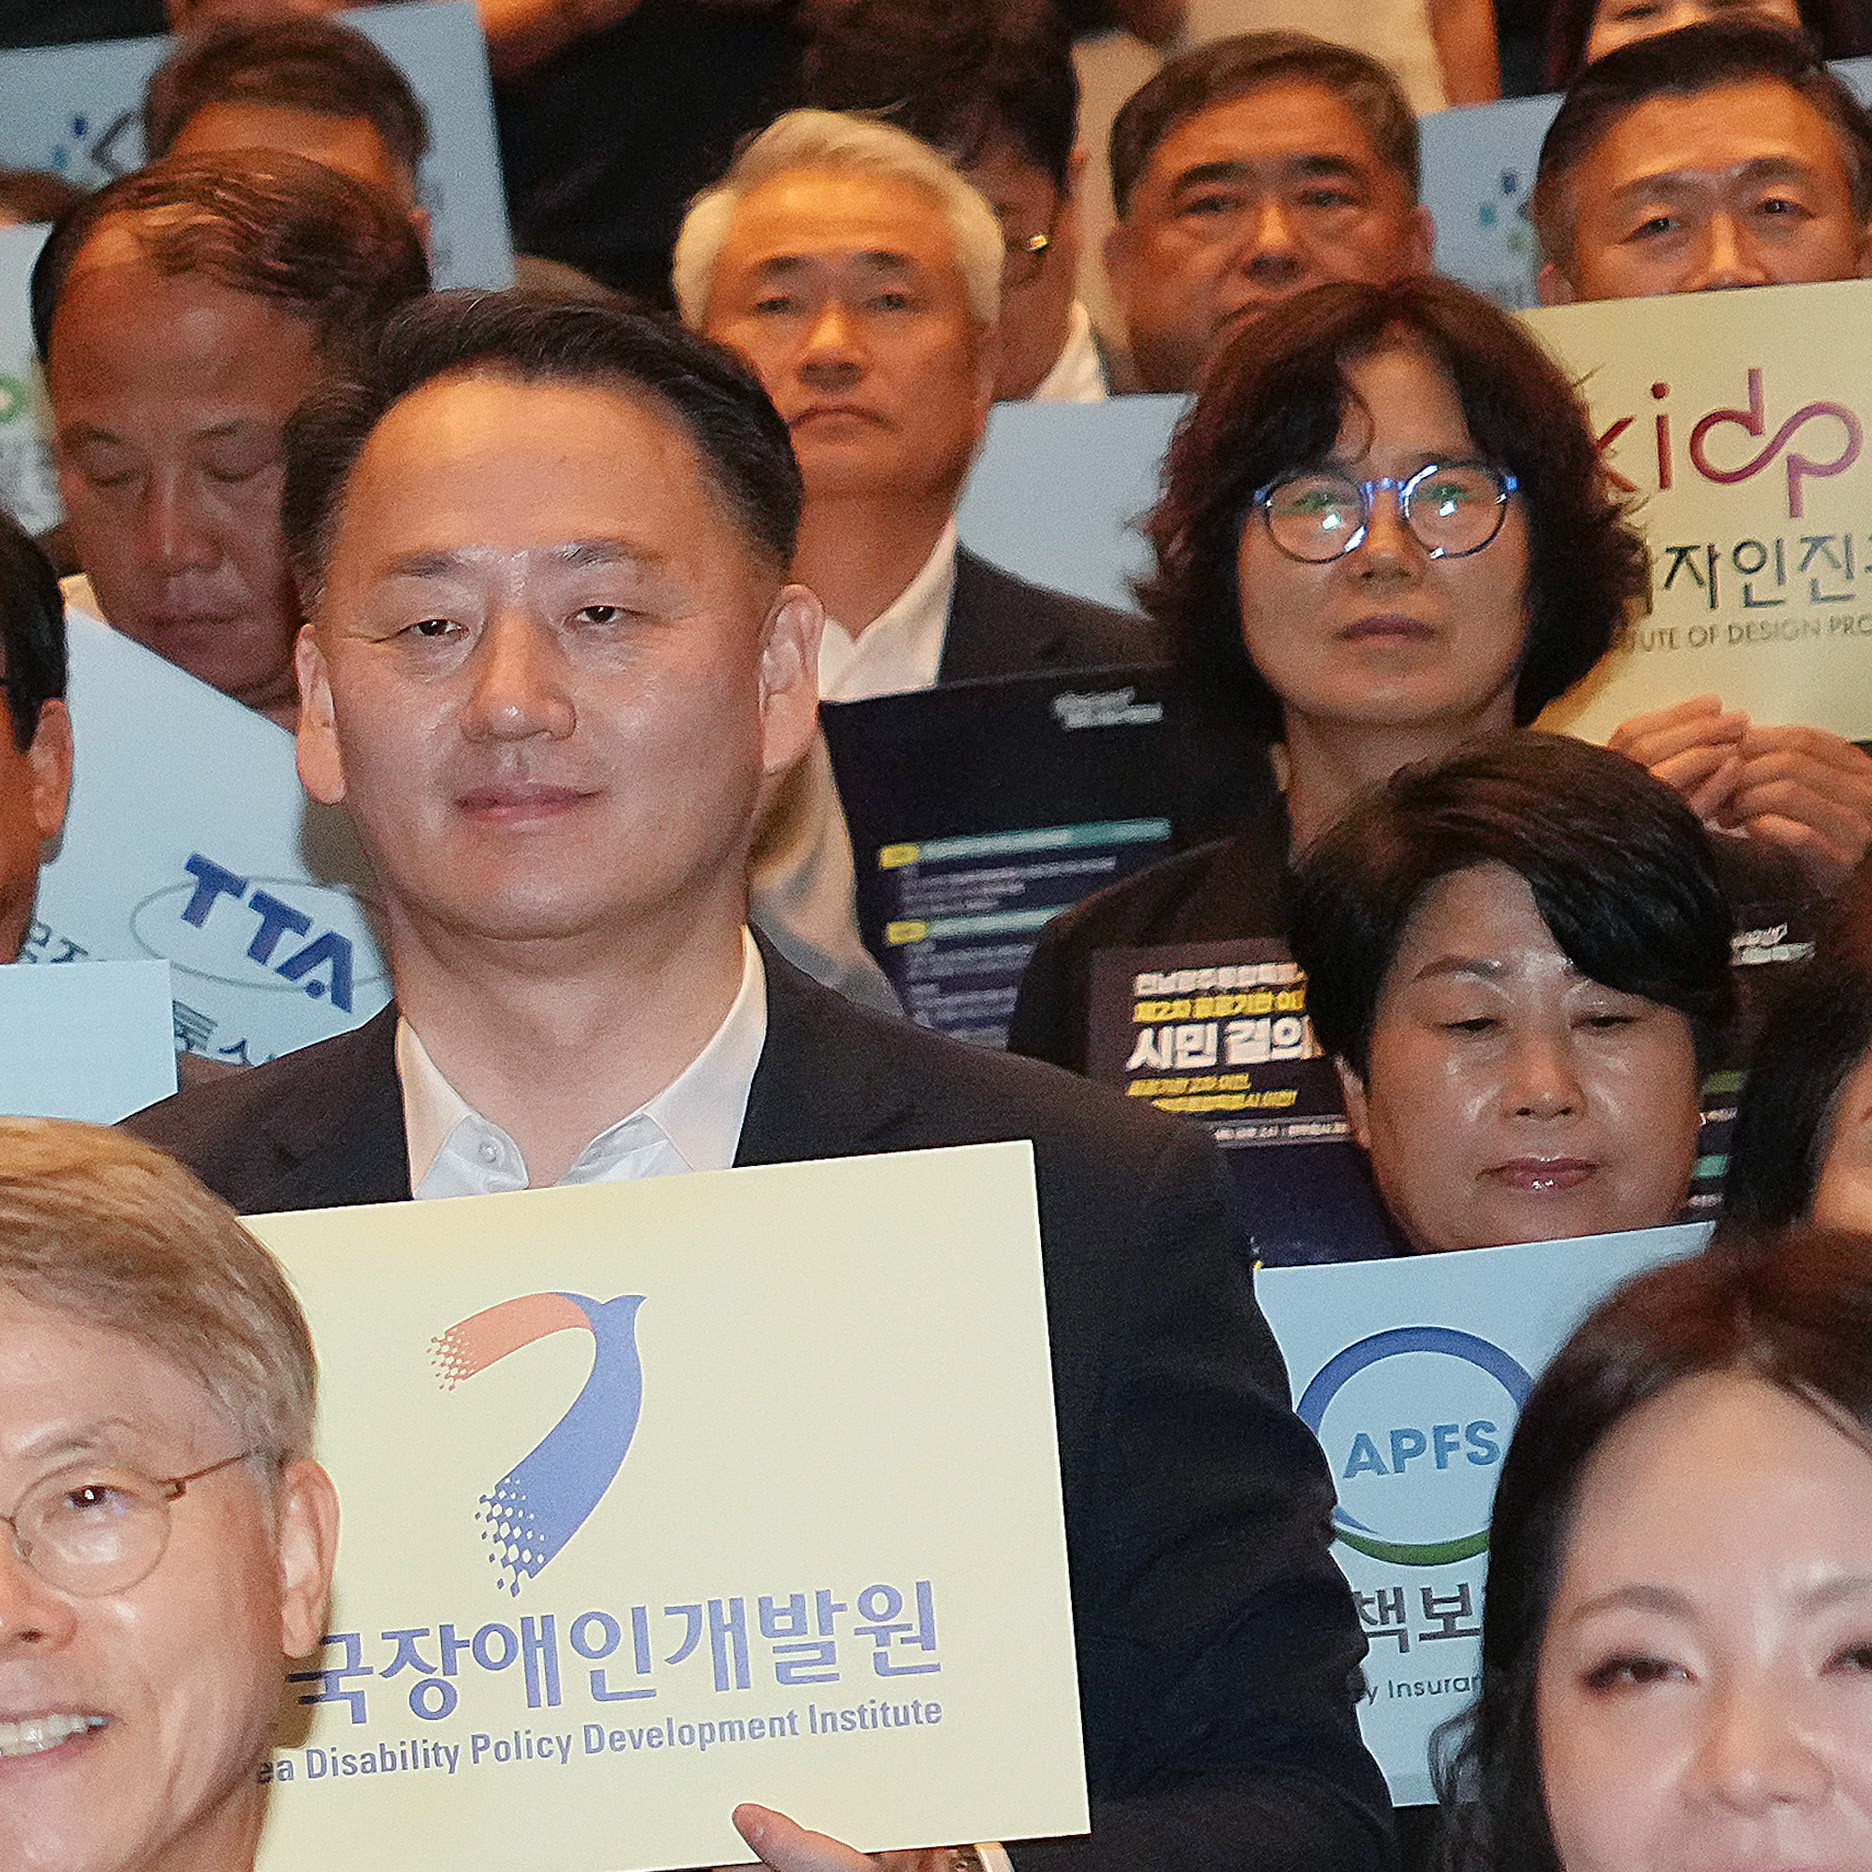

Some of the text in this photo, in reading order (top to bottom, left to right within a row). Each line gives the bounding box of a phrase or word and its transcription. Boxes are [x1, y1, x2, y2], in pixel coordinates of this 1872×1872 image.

[181, 852, 353, 1014] TTA
[1125, 1014, 1324, 1073] 시민 결의
[1342, 1419, 1501, 1480] APFS
[306, 1738, 460, 1780] Disability
[471, 1729, 573, 1766] Policy
[584, 1707, 799, 1757] Development
[808, 1697, 944, 1737] Institute
